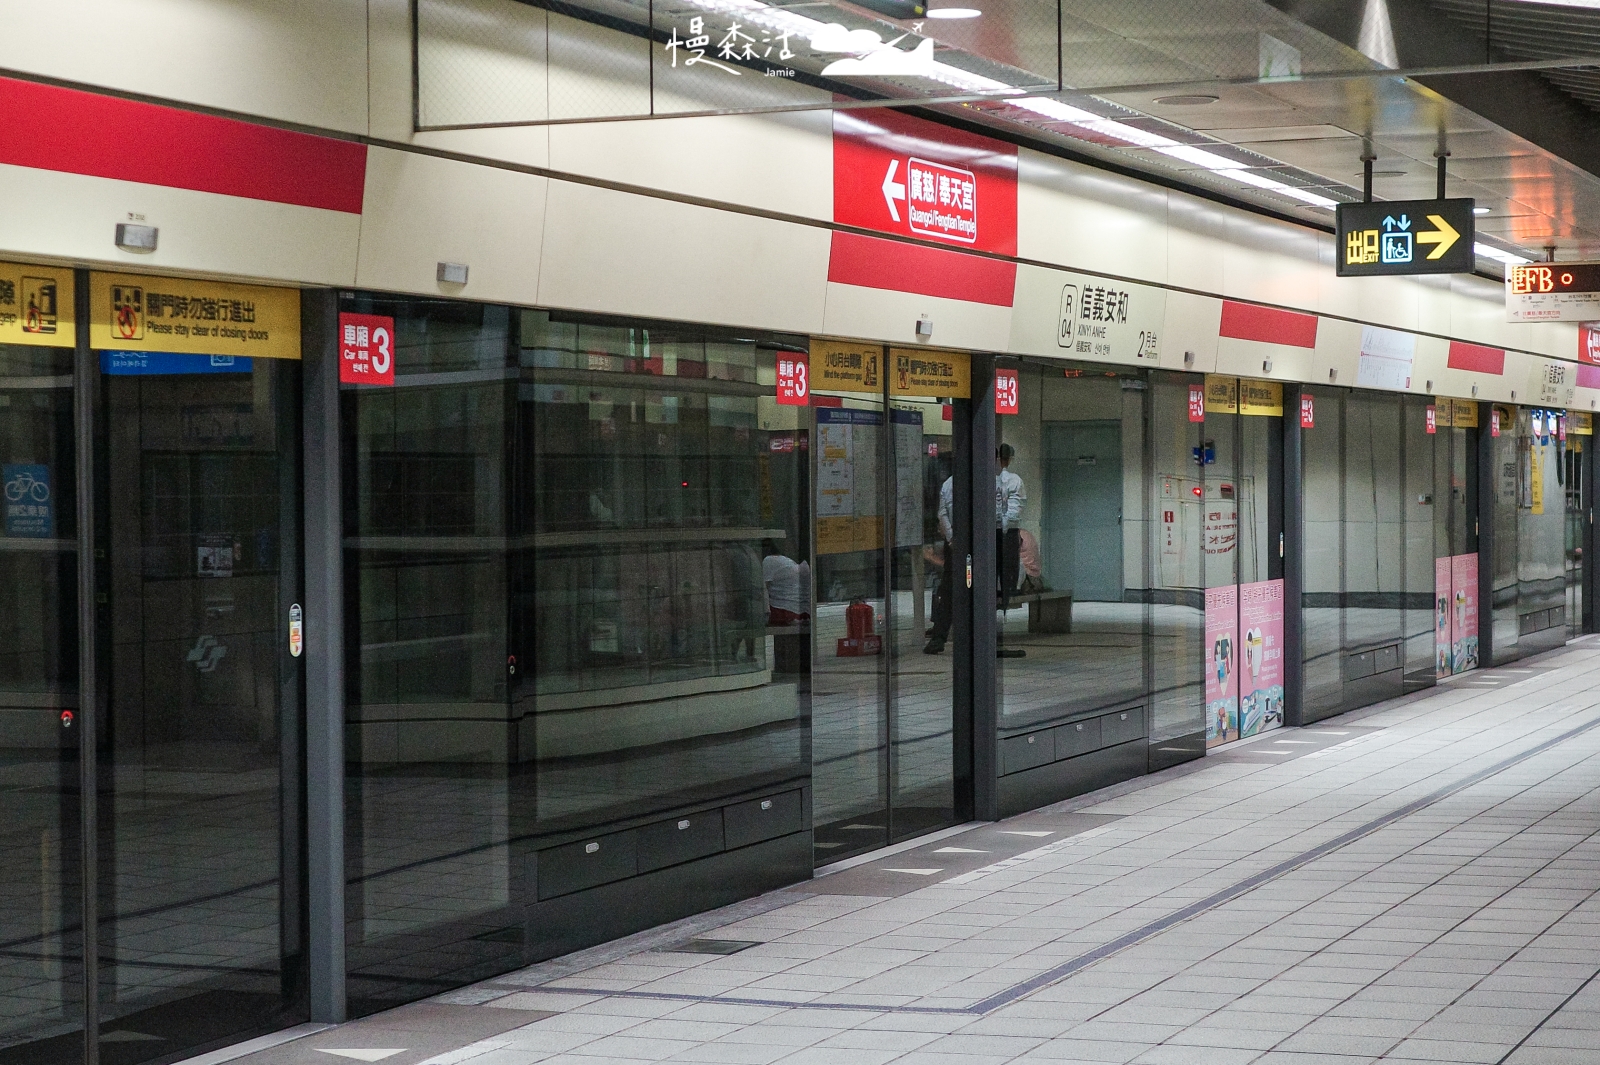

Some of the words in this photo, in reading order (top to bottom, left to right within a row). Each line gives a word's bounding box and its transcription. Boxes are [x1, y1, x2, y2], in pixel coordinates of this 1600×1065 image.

[911, 168, 974, 212] 廣慈/奉天宮
[956, 215, 975, 235] Temple
[1347, 229, 1379, 264] 出口
[1363, 253, 1379, 263] EXIT
[1066, 294, 1073, 313] R
[1080, 284, 1128, 324] 信義安和
[147, 321, 172, 334] Please
[174, 323, 190, 338] stay
[191, 324, 209, 336] clear
[211, 325, 219, 337] of
[221, 325, 247, 341] closing
[248, 328, 268, 340] doors
[344, 324, 368, 347] 車廂
[1061, 319, 1072, 338] 04
[1077, 324, 1092, 337] XINYI
[1092, 326, 1107, 339] ANHE
[1145, 332, 1157, 348] 月台
[344, 349, 356, 360] Car
[372, 327, 390, 374] 3
[1137, 330, 1145, 358] 2
[779, 360, 794, 377] 車廂
[795, 361, 806, 397] 3
[1008, 377, 1016, 407] 3
[1197, 391, 1203, 416] 3
[1308, 400, 1313, 423] 3
